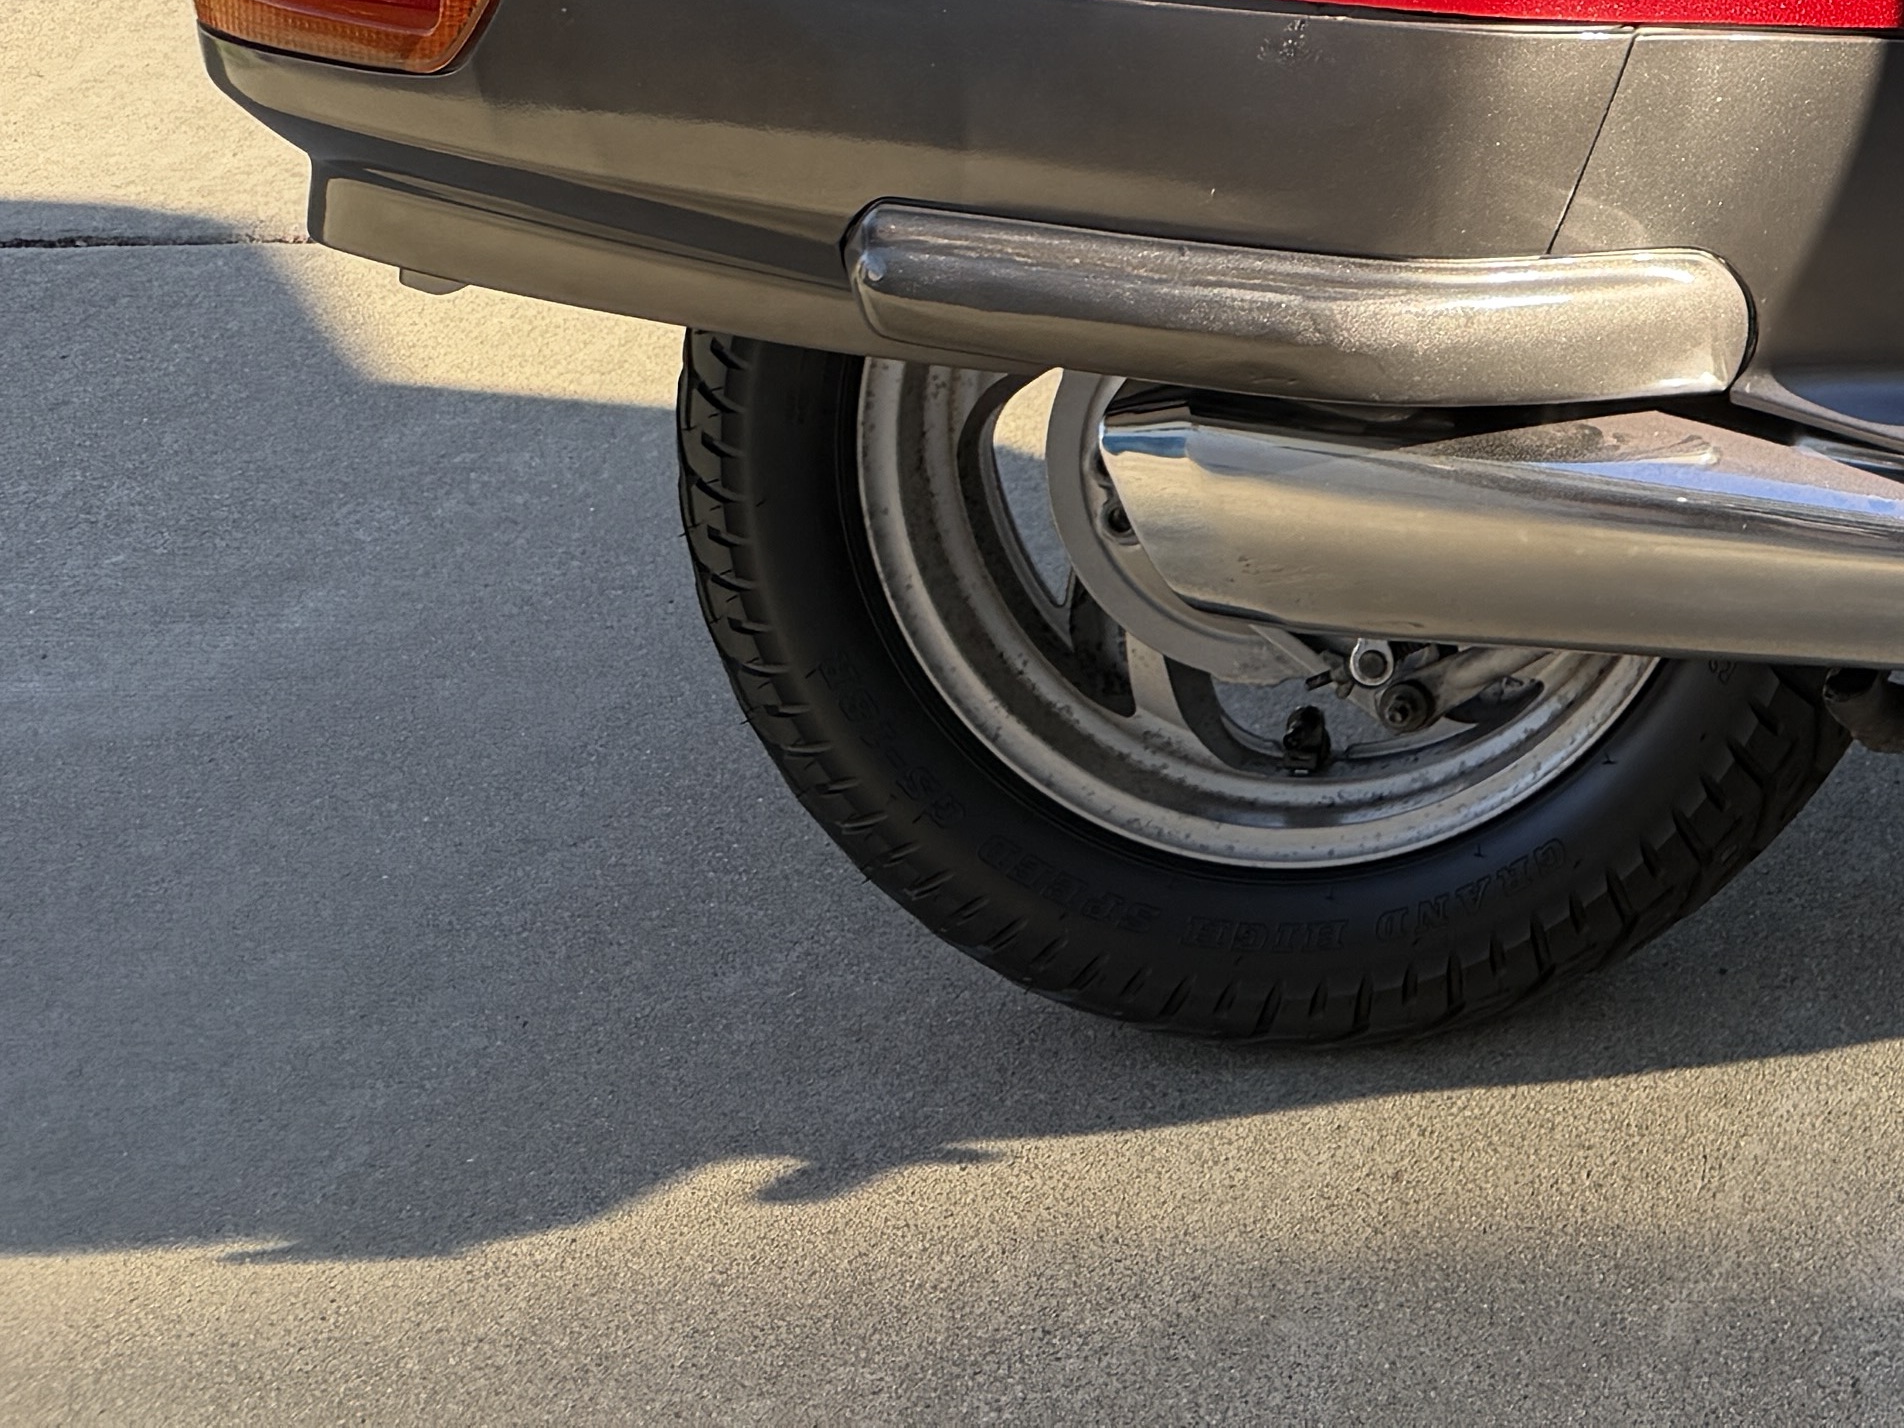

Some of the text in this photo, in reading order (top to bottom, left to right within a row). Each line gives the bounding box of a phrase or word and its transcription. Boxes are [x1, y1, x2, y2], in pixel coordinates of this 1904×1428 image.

[977, 835, 1160, 932] SPEED
[1375, 839, 1567, 944] GRAND
[1178, 917, 1350, 954] HIGH
